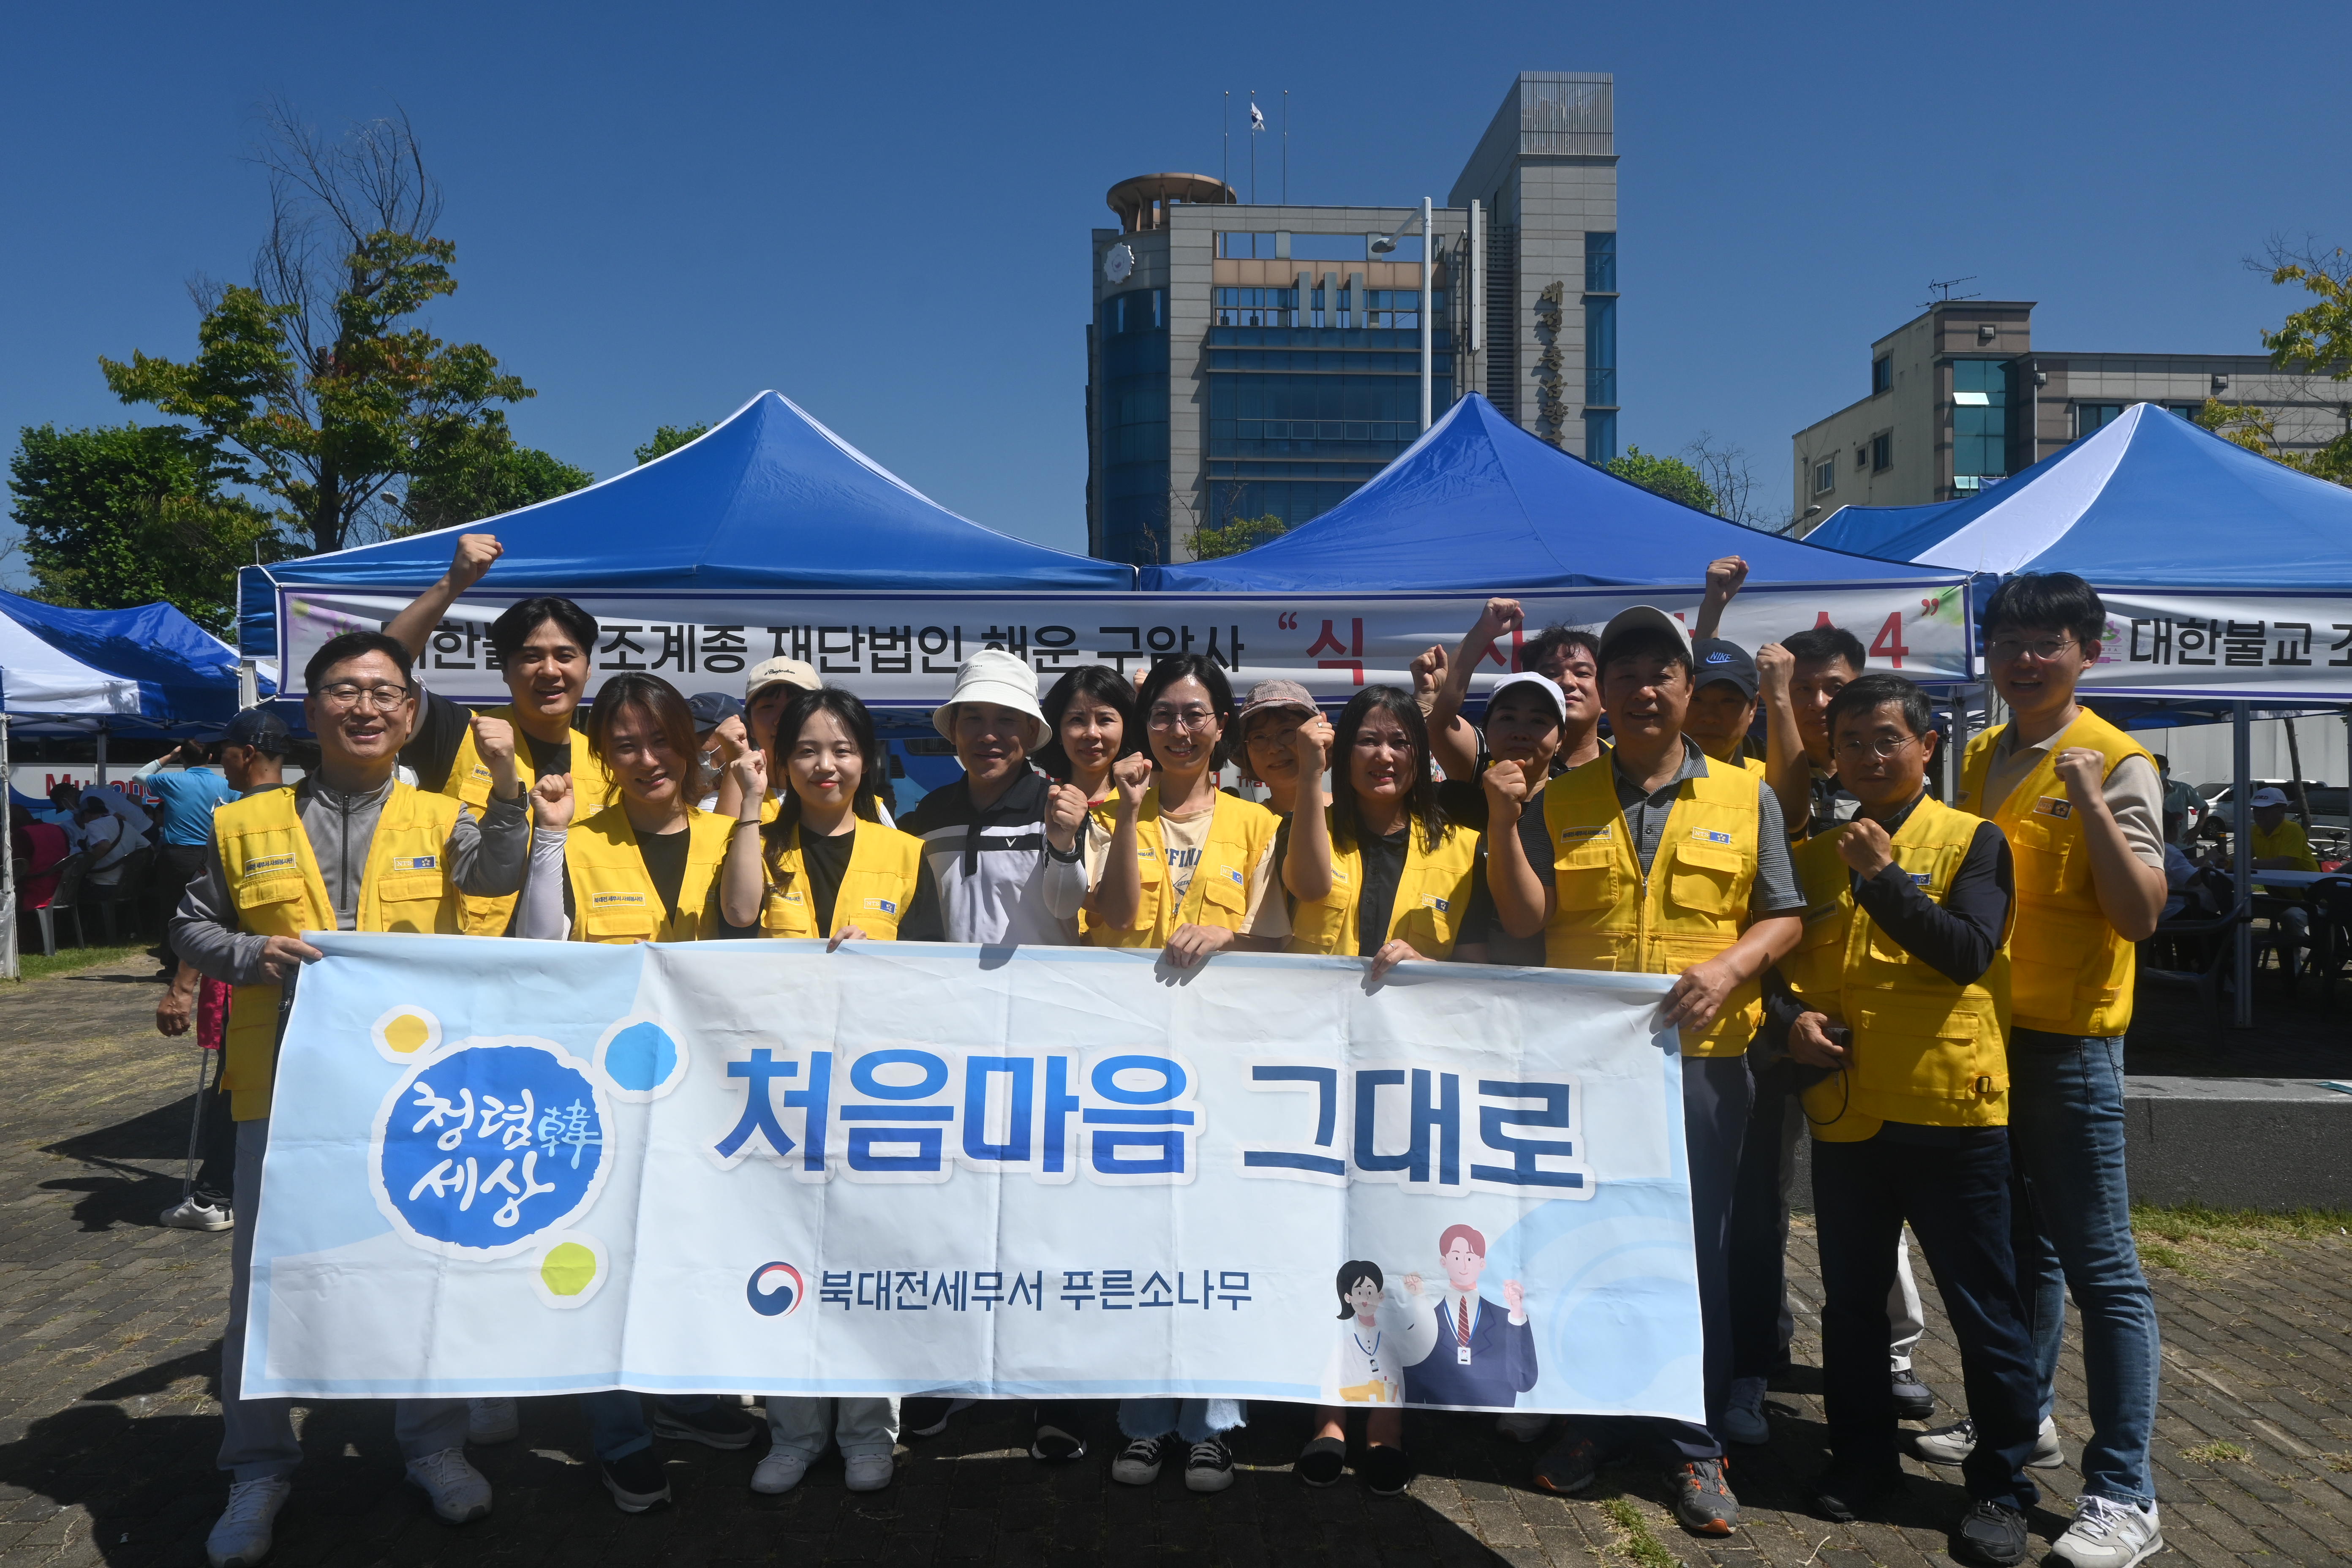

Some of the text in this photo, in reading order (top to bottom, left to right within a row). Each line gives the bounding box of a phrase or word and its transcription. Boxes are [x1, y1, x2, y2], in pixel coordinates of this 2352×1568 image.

[600, 625, 748, 674] 조계종
[766, 626, 961, 674] 재단법인
[1710, 651, 1732, 661] NIKE
[2129, 617, 2312, 667] 대한불교
[715, 1048, 1585, 1190] 처음마음 그대로
[408, 1151, 555, 1228] 세상
[819, 1270, 1253, 1313] 북대전세무서 푸른소나무
